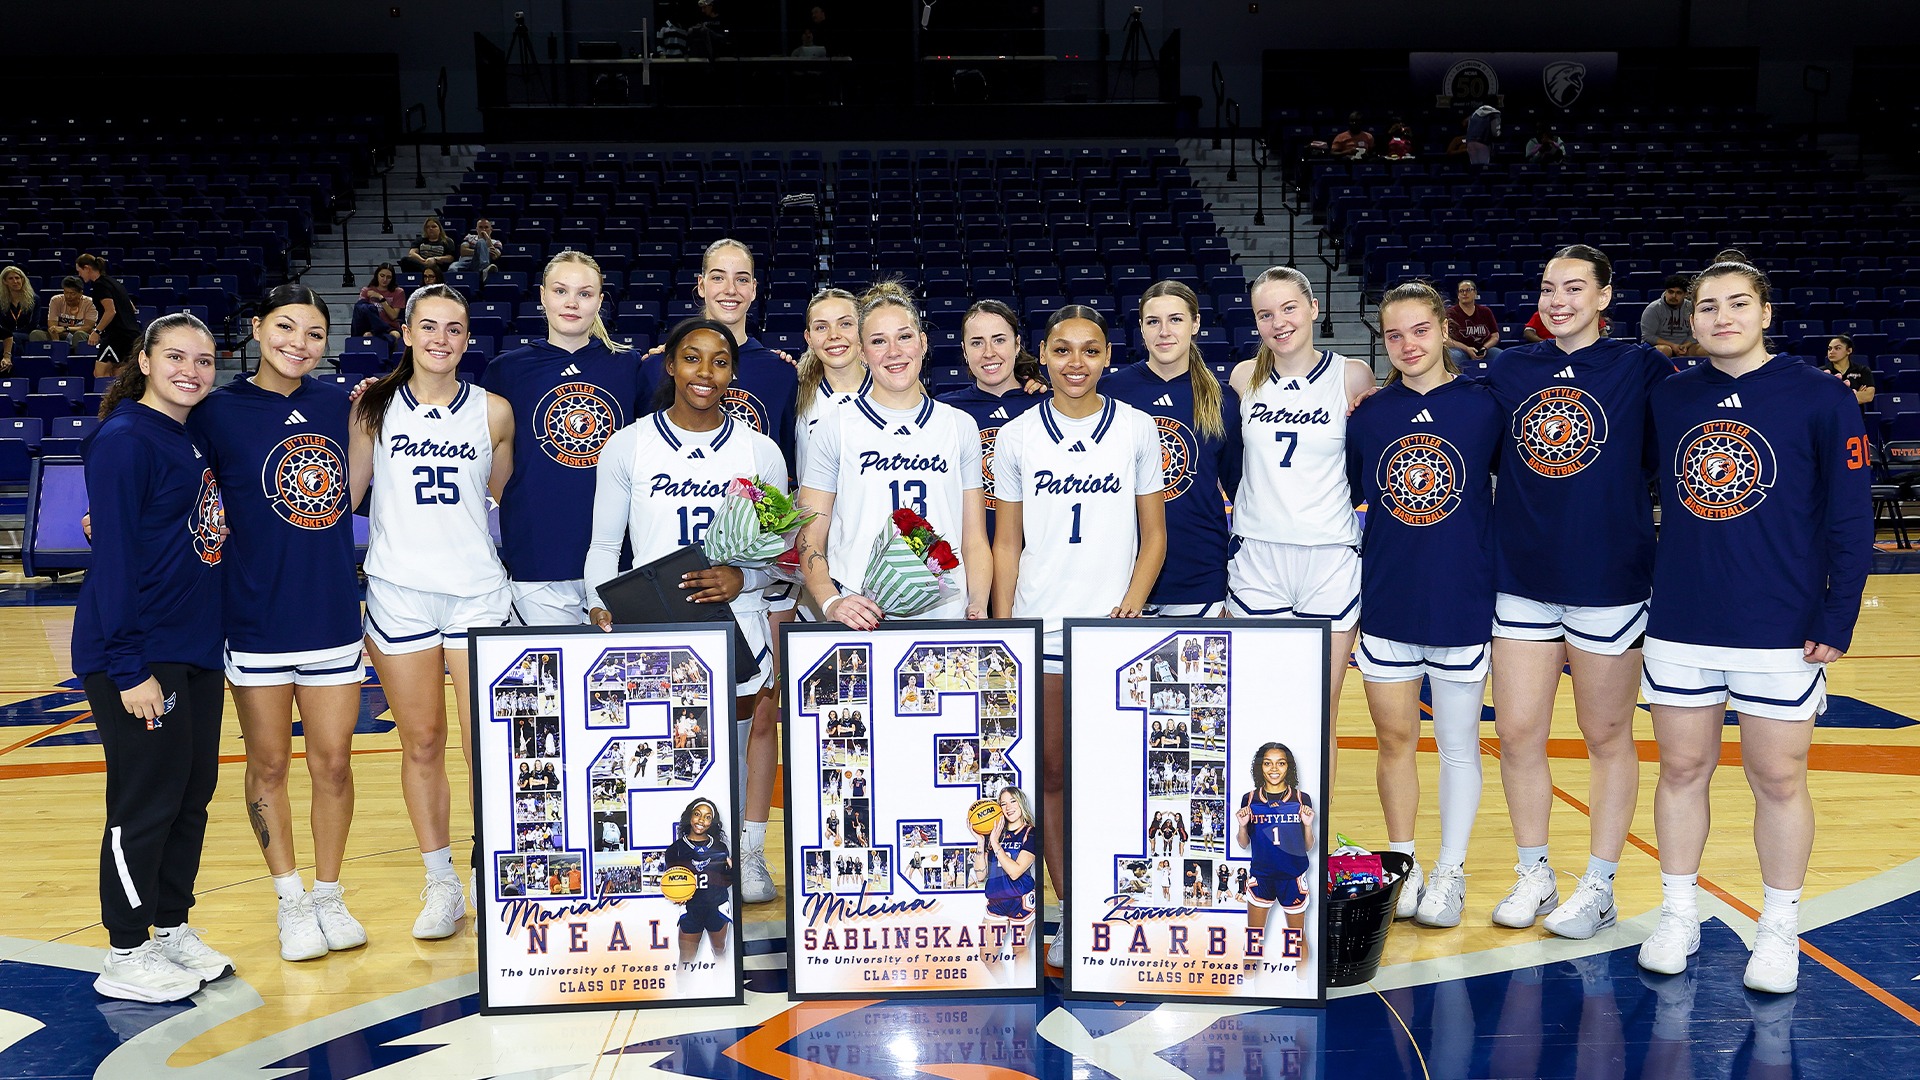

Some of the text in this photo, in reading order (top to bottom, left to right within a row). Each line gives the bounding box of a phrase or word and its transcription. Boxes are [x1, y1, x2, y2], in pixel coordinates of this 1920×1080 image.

[1457, 77, 1484, 97] 50
[1248, 403, 1331, 425] Patriots
[390, 434, 478, 461] Patriots
[556, 452, 600, 466] BASKETB
[1275, 431, 1298, 467] 7
[859, 451, 949, 474] Patriots
[1528, 458, 1586, 475] BASKETBALL
[412, 466, 460, 505] 25
[650, 473, 732, 498] Patriot
[1033, 471, 1122, 496] Patriots
[888, 480, 927, 519] 13
[1684, 496, 1749, 518] BASKETBALL
[289, 508, 341, 528] BASKETBALL
[677, 506, 715, 546] 12
[1069, 503, 1082, 543] 1
[1392, 508, 1448, 524] BASKETBALL
[489, 645, 716, 902] 12
[797, 640, 1022, 896] 13
[1114, 630, 1252, 914] 1
[977, 807, 995, 819] NCAA
[1266, 814, 1301, 823] TYLER
[1272, 827, 1280, 845] 1
[501, 881, 622, 936] Mariah
[802, 881, 936, 927] Mileina
[1102, 894, 1197, 924] Zionna
[527, 919, 669, 954] NEAL
[804, 924, 1027, 951] SABLINSKAITE
[1091, 922, 1303, 959] BARBEE
[501, 961, 716, 977] The University of Texas at Tyler
[807, 953, 1017, 965] The University of Texas at Tyler
[1082, 956, 1297, 973] The University of Texas at Tyler
[559, 978, 666, 993] CLASS OF 2026
[863, 968, 967, 981] CLASS OF 2026
[1138, 971, 1244, 985] CLASS OF 2026
